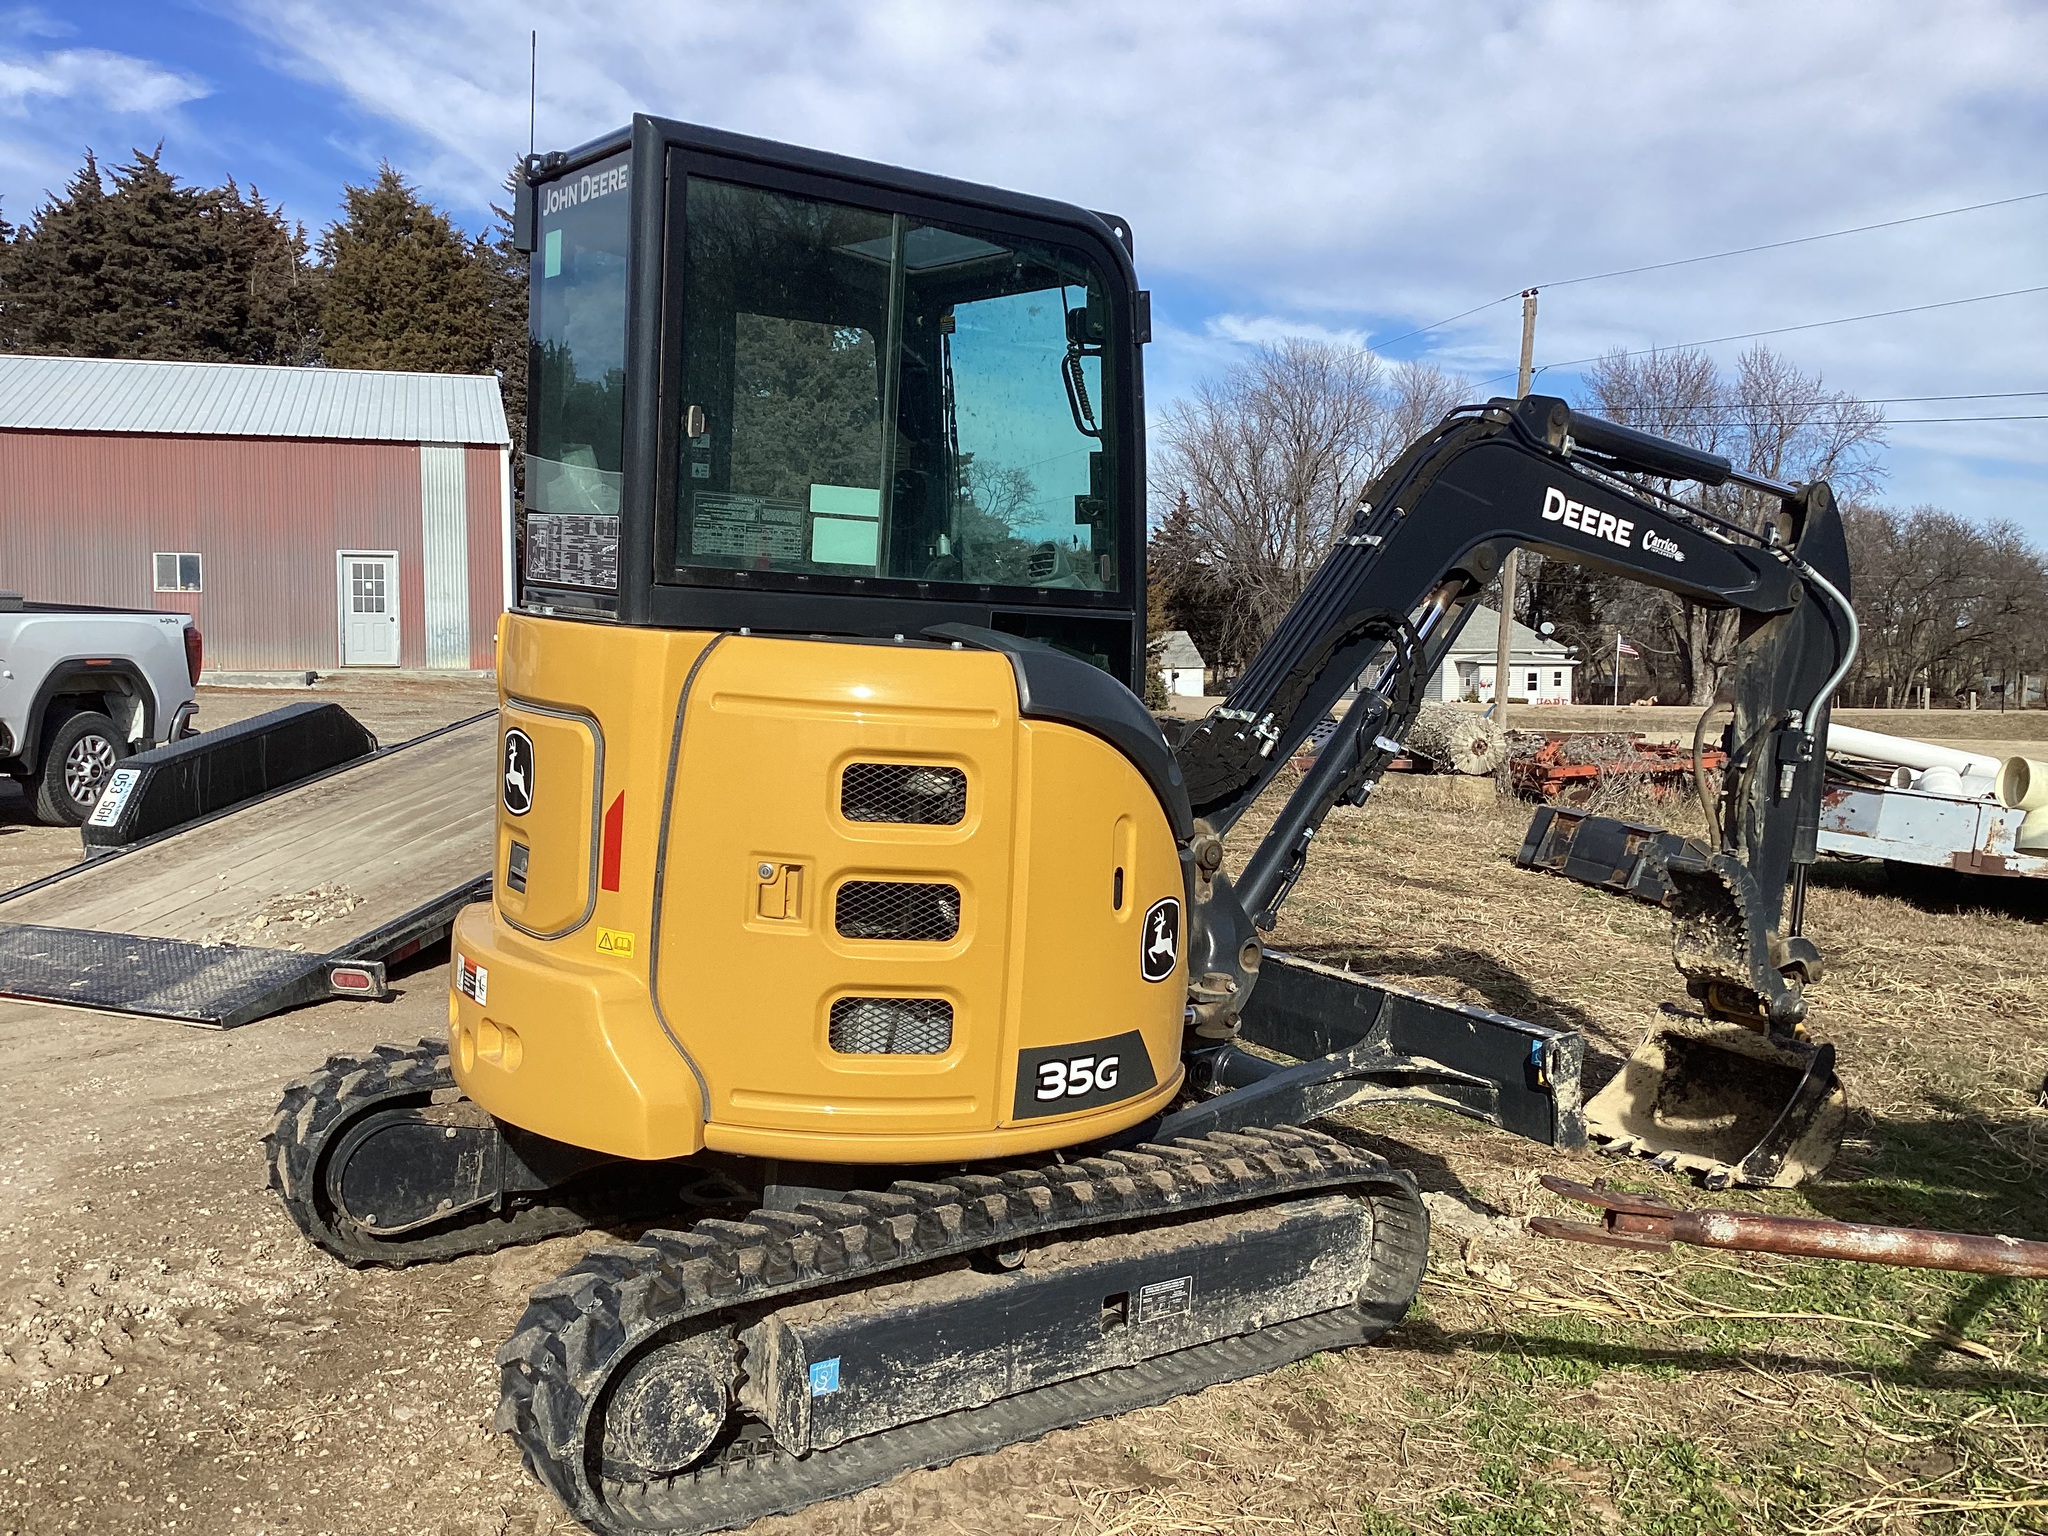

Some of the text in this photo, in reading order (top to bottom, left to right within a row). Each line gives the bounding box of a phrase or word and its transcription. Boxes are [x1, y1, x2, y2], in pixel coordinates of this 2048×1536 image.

[543, 164, 628, 216] JOHN DEERE
[1541, 486, 1635, 548] DEERE
[1642, 529, 1678, 553] Carrico
[94, 773, 130, 823] 053 SGH
[1037, 1056, 1119, 1100] 35G
